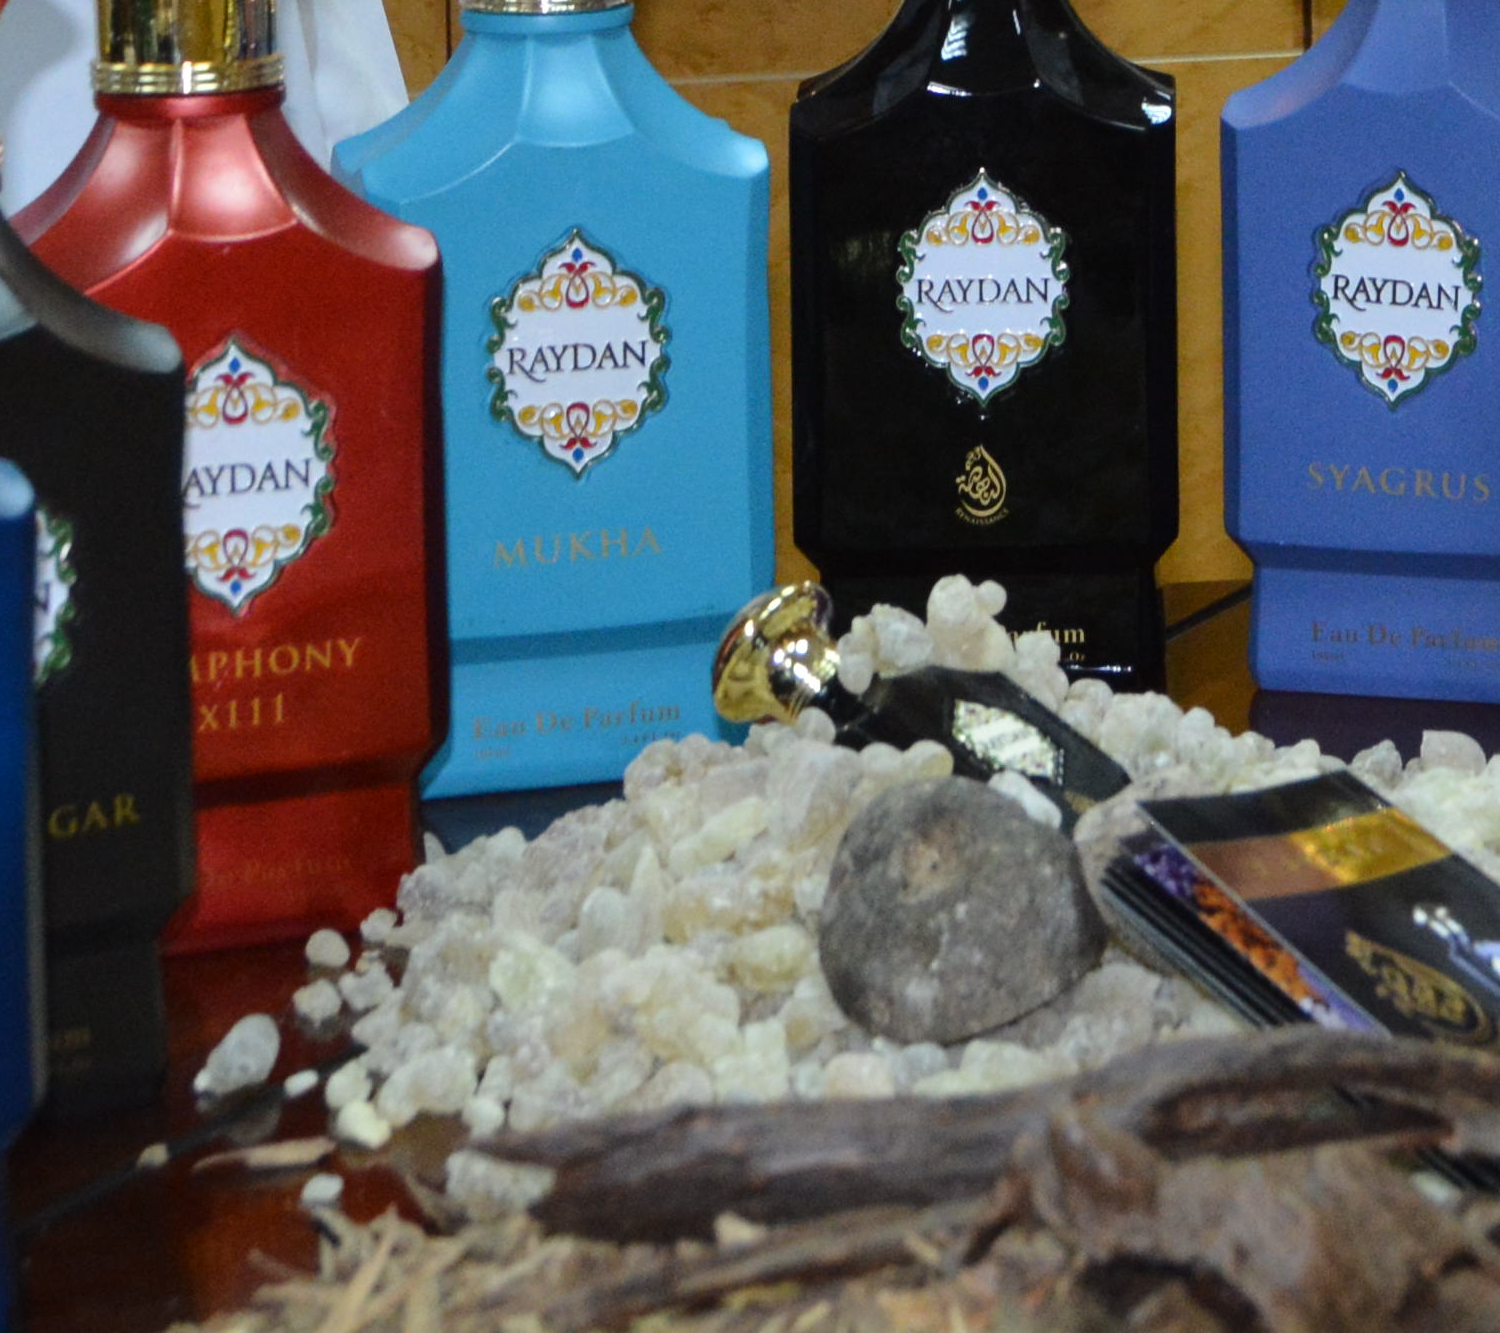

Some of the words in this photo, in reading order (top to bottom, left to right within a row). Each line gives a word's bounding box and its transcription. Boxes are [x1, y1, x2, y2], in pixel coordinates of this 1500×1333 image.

[916, 276, 1050, 313] RAYDAN
[1331, 275, 1461, 312] RAYDAN
[506, 340, 648, 383] RAYDAN
[184, 457, 313, 509] AYDAN
[1307, 462, 1491, 503] SYAGRUS
[493, 526, 663, 570] MUKHA
[189, 637, 363, 683] PHONY
[49, 792, 141, 840] GAR
